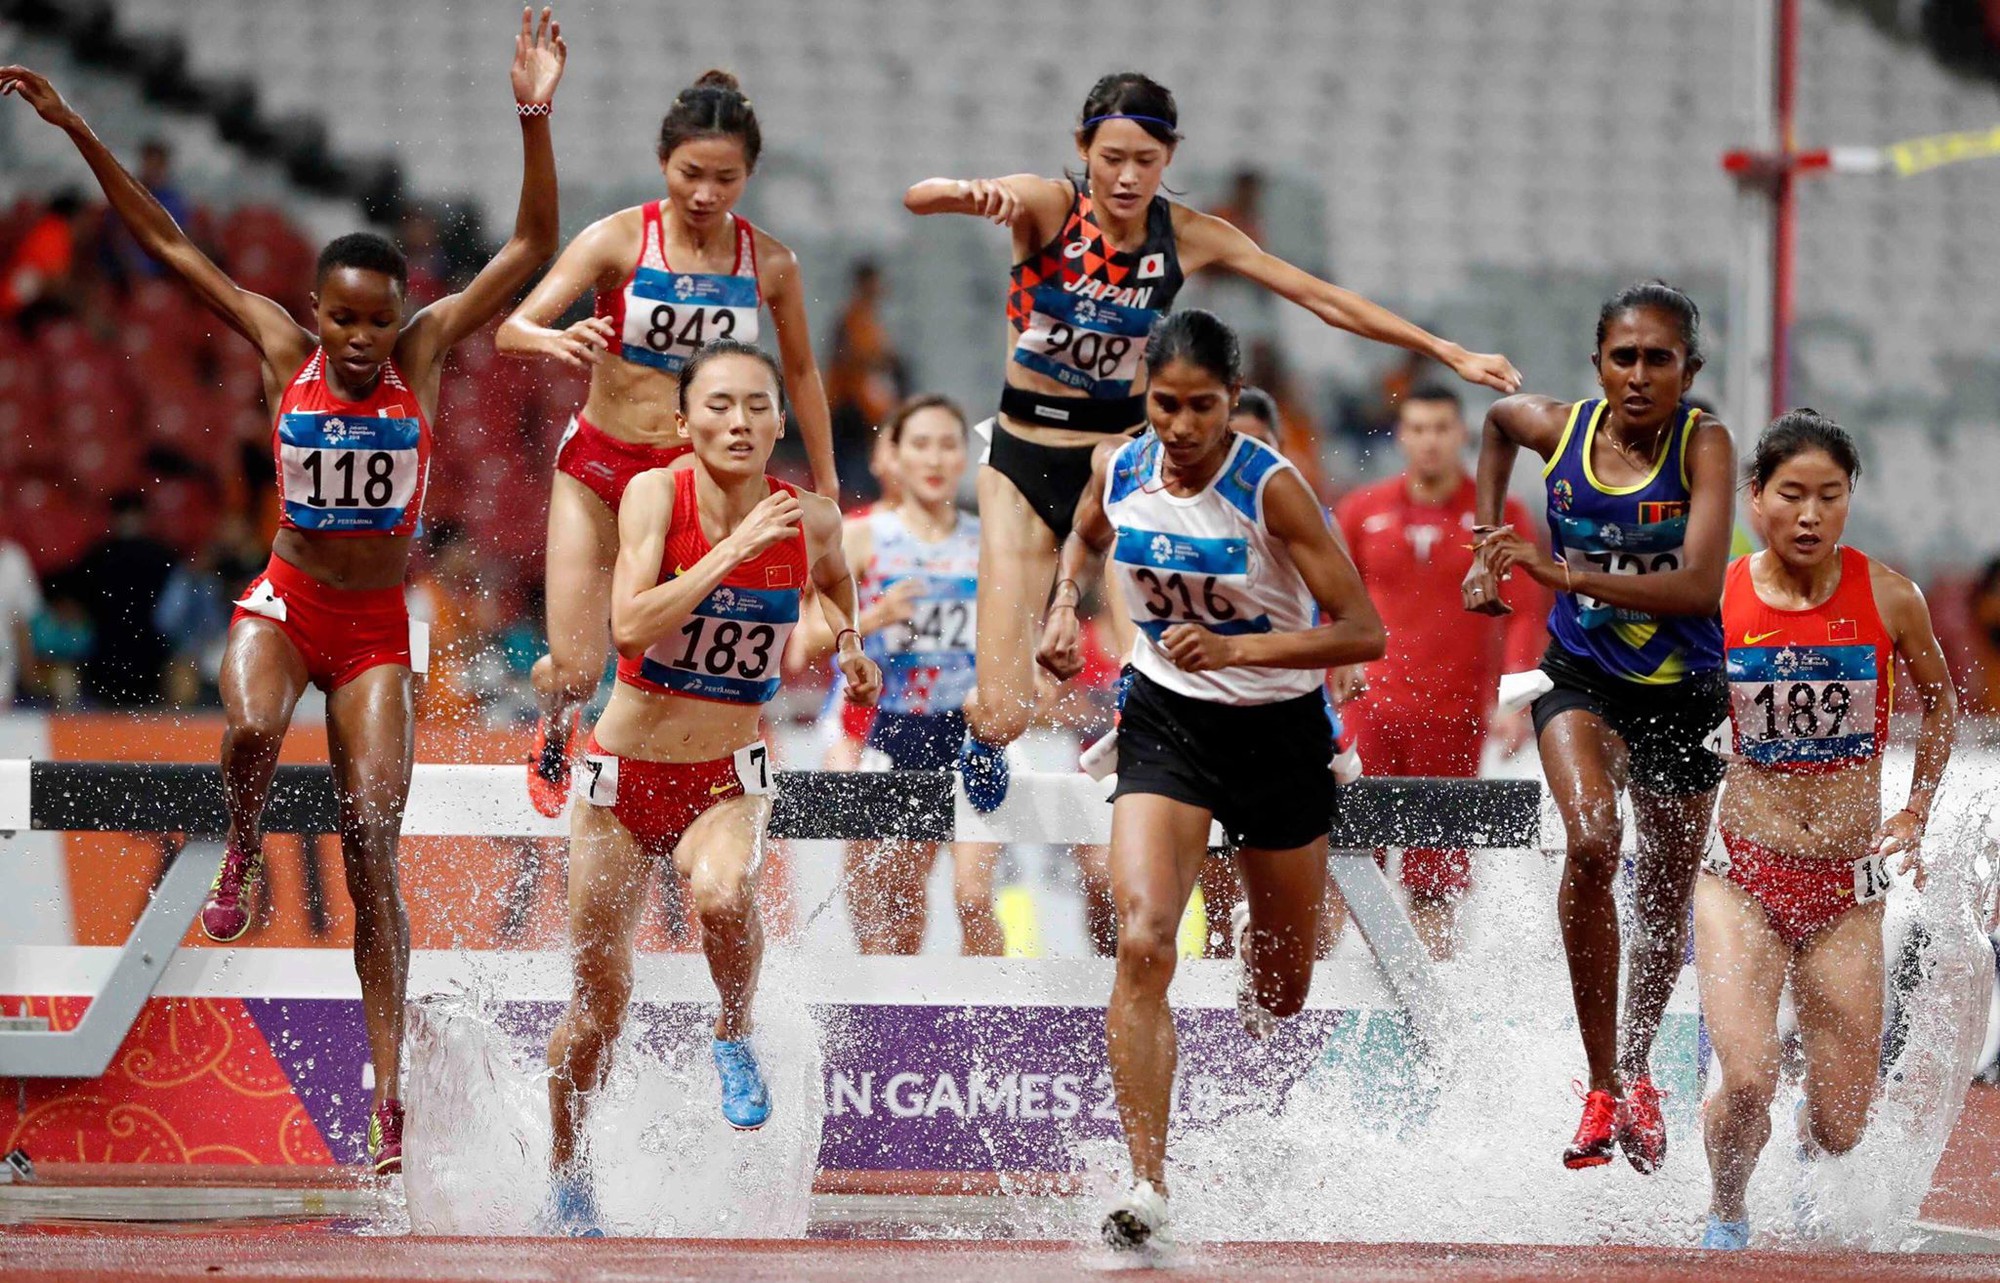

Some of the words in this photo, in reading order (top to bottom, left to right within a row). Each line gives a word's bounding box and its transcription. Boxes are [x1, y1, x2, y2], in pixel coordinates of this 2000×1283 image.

[1063, 274, 1153, 309] JAPAN
[646, 304, 735, 352] 843
[302, 450, 394, 507] 118
[1136, 568, 1236, 620] 316
[672, 617, 775, 679] 183
[704, 685, 740, 695] PERTAMINA
[1754, 682, 1851, 740] 189
[587, 760, 602, 799] 7
[749, 746, 767, 788] 7
[885, 1070, 1082, 1119] GAMES
